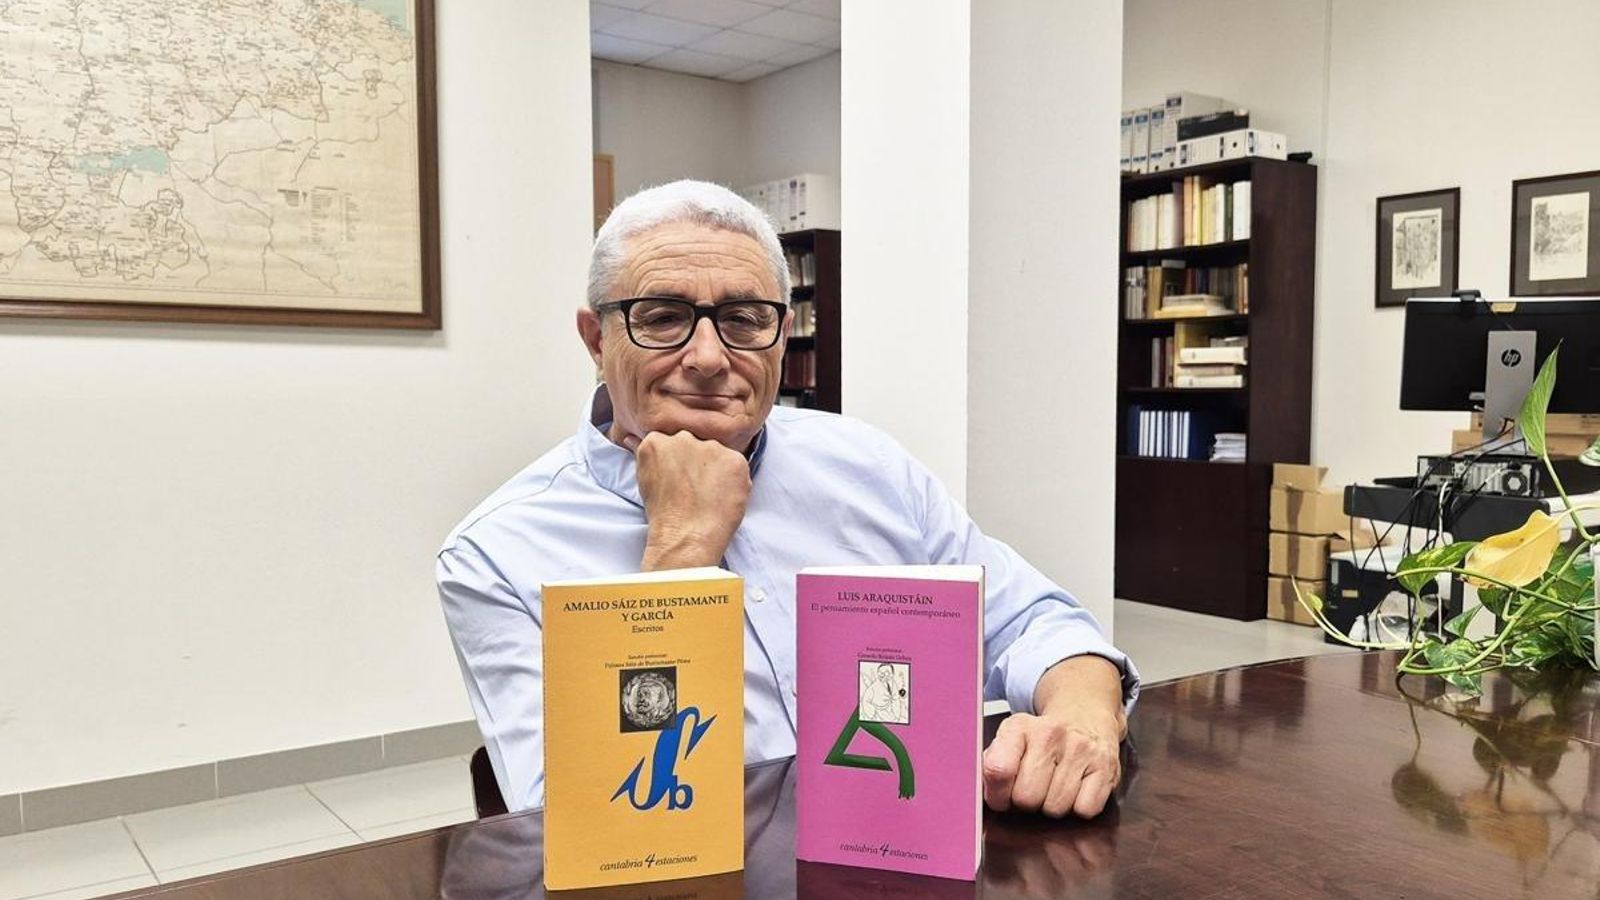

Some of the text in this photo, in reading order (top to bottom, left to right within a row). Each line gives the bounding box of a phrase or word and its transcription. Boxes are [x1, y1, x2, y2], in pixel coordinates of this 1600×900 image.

[1503, 349, 1520, 367] hp
[563, 595, 729, 612] AMALIO SÁIZ DE BUSTAMANTE
[837, 591, 934, 605] LUIS ARAQUISTÁIN
[621, 609, 674, 622] Y GARCÍA
[811, 603, 961, 620] El pensamiento español contemporáneo
[631, 625, 665, 634] Escritos
[839, 840, 929, 862] cantabria 4 estaciones
[599, 853, 698, 871] cantabria 4 estaciones
